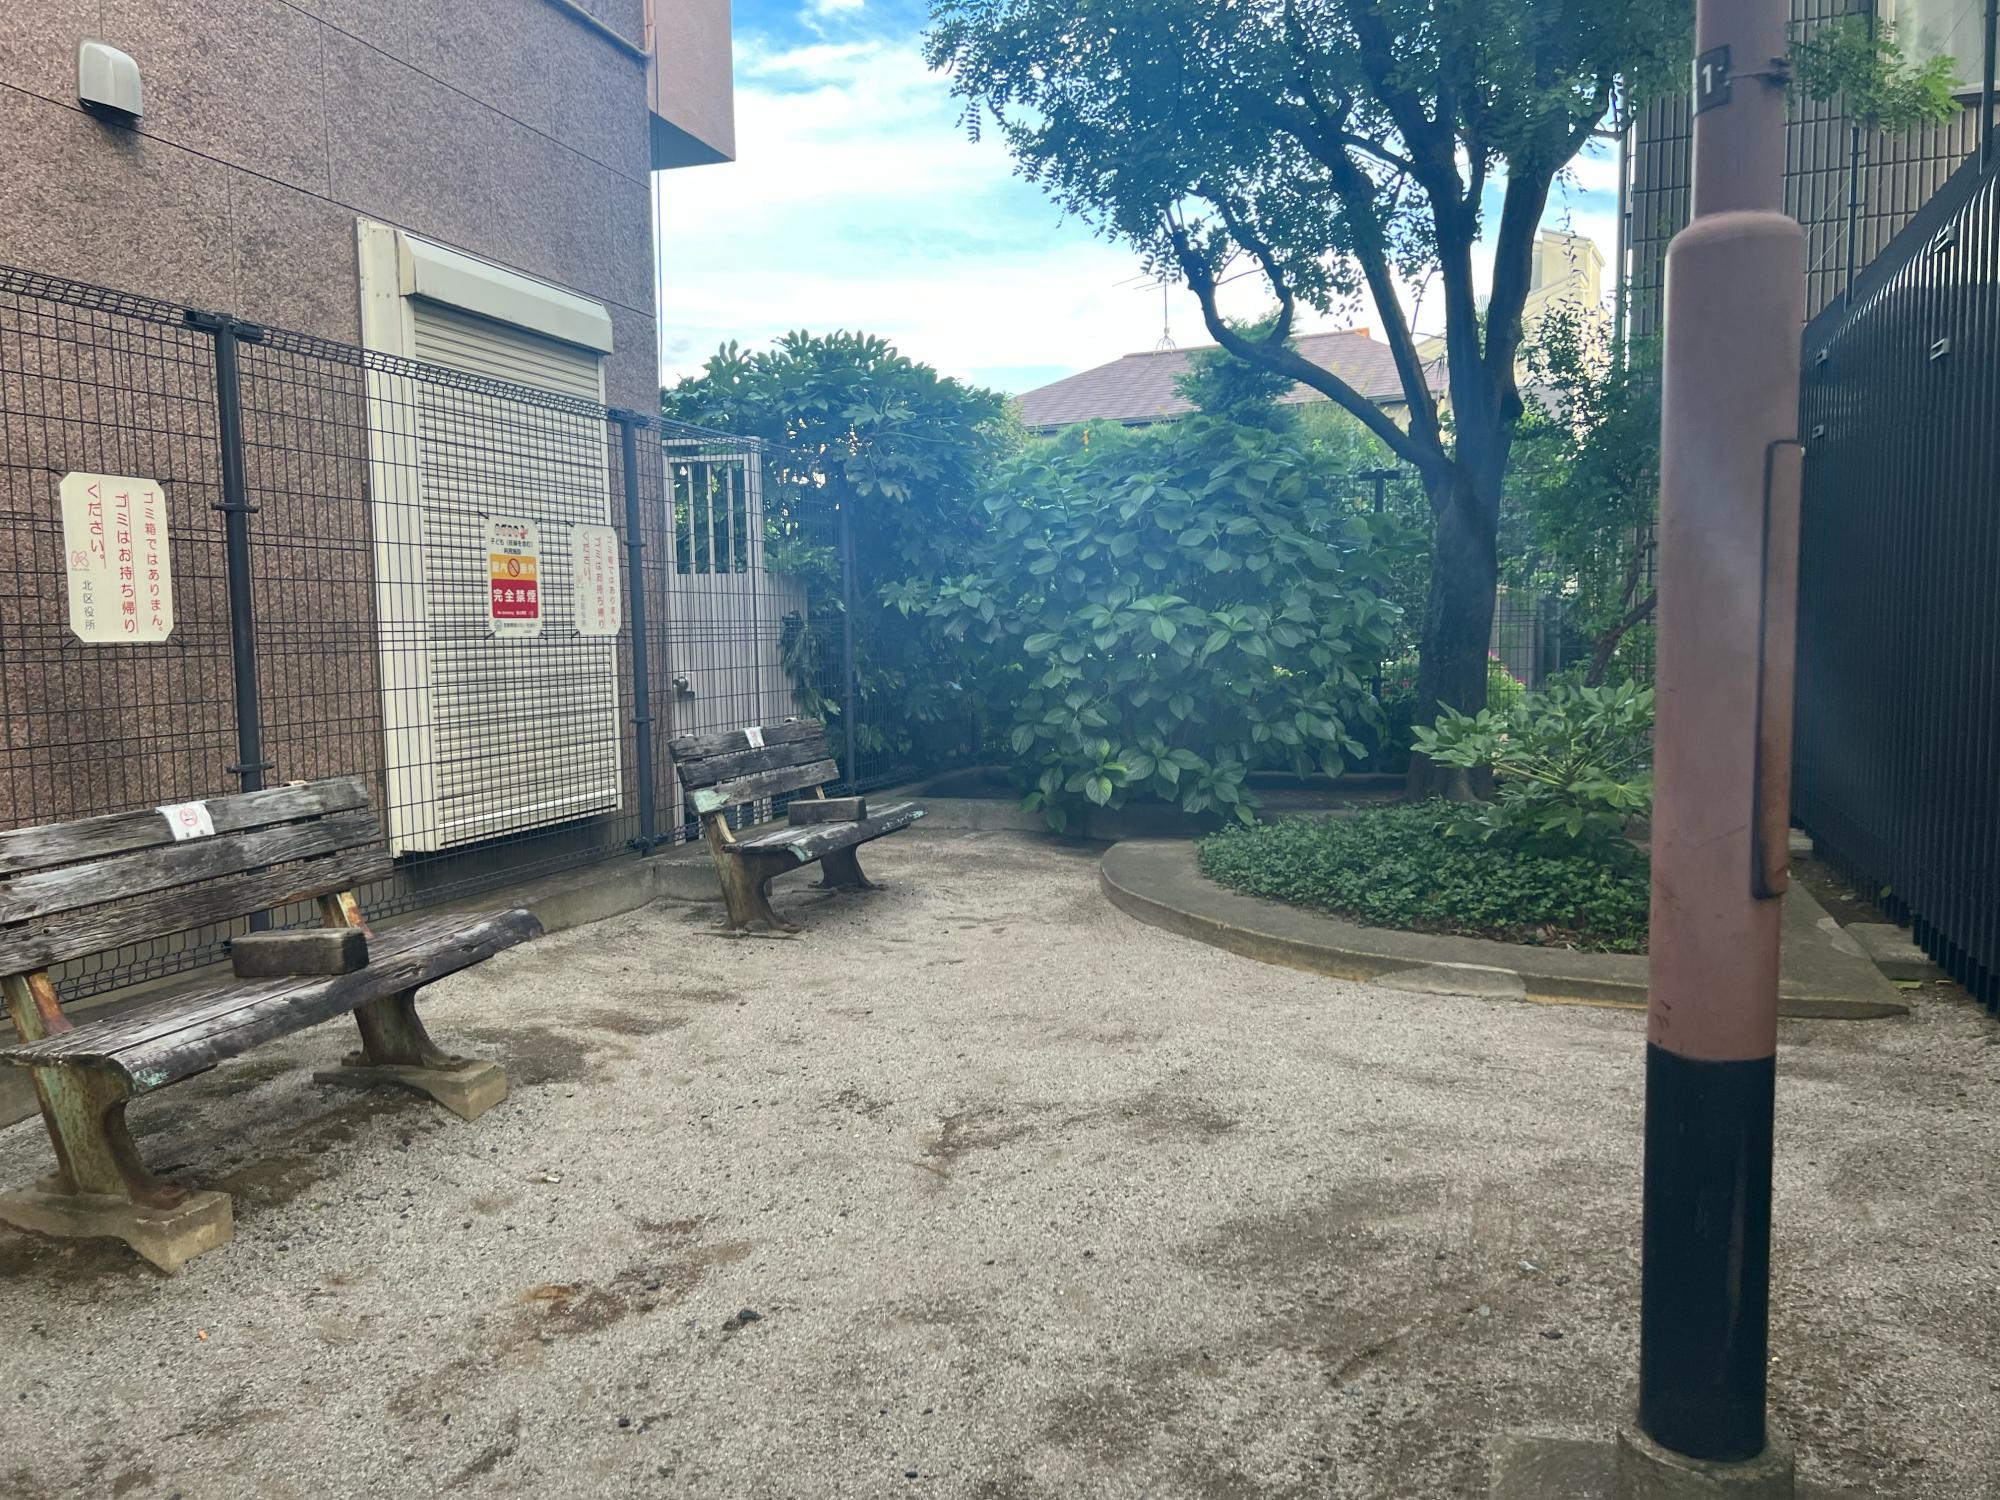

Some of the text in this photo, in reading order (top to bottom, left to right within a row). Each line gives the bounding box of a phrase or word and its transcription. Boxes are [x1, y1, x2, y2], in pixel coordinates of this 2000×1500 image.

[1702, 64, 1712, 94] 1
[87, 483, 105, 560] ください。
[114, 493, 136, 634] ゴミはお持ち帰り
[143, 491, 163, 632] ゴミ箱ではありまん。
[82, 580, 95, 630] 北区役所
[493, 587, 537, 603] 完全禁煙
